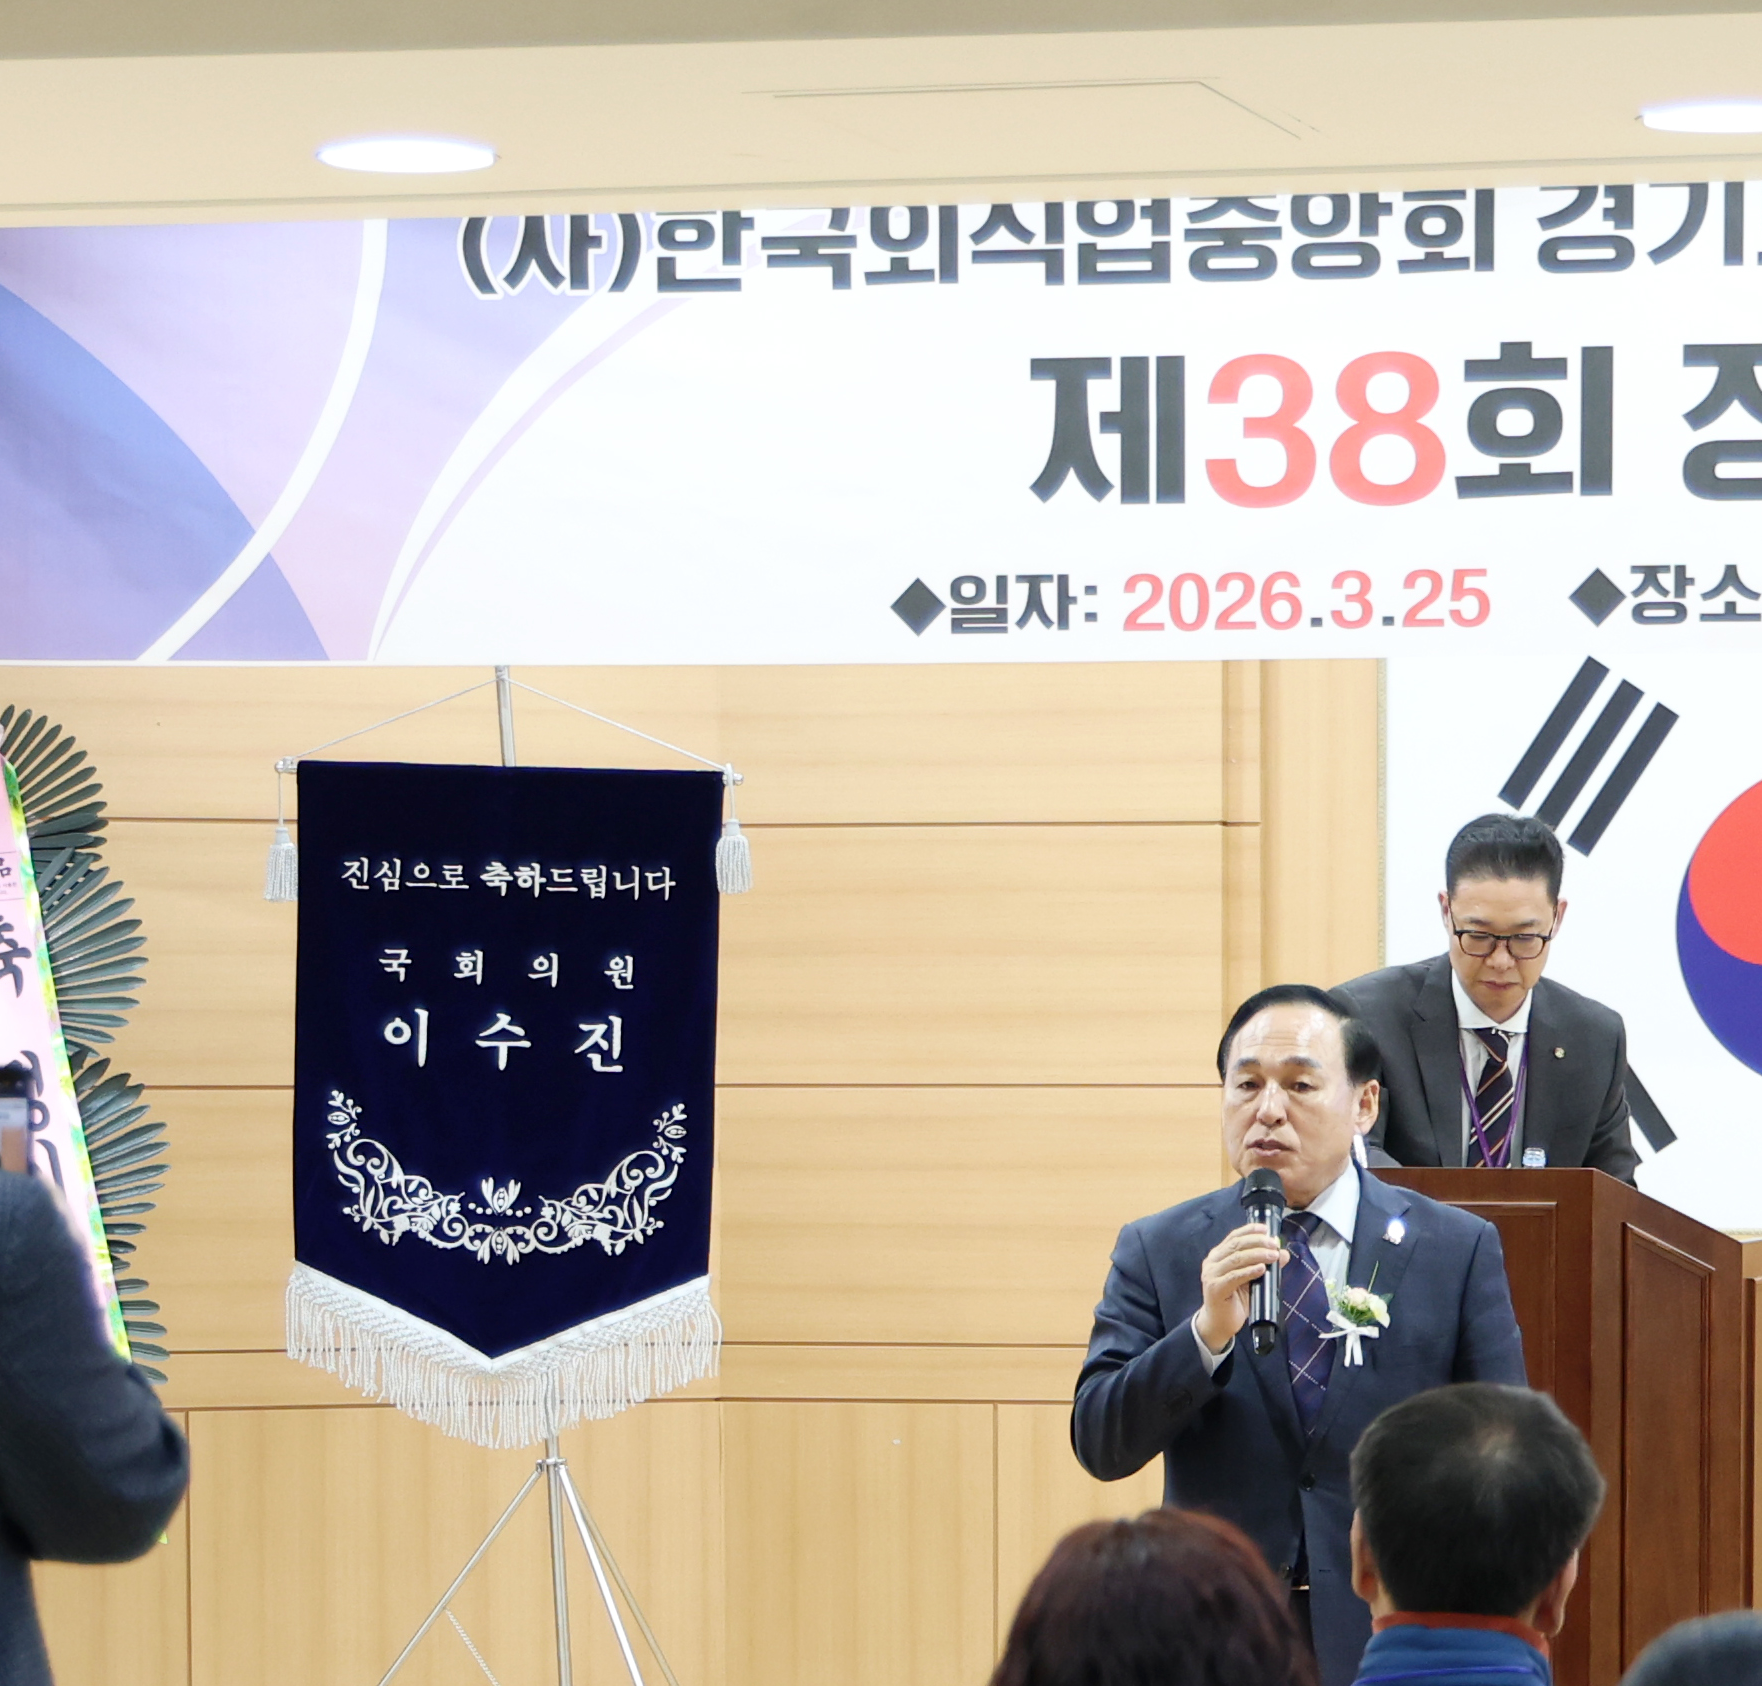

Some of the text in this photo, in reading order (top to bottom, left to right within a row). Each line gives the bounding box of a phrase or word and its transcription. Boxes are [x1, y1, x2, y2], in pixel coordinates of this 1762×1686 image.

[462, 187, 1495, 295] (사)한국외식업중앙회
[1029, 341, 1615, 508] 제38회
[1122, 567, 1491, 632] 2026.3.25
[341, 857, 676, 900] 진심으로 축하드립니다
